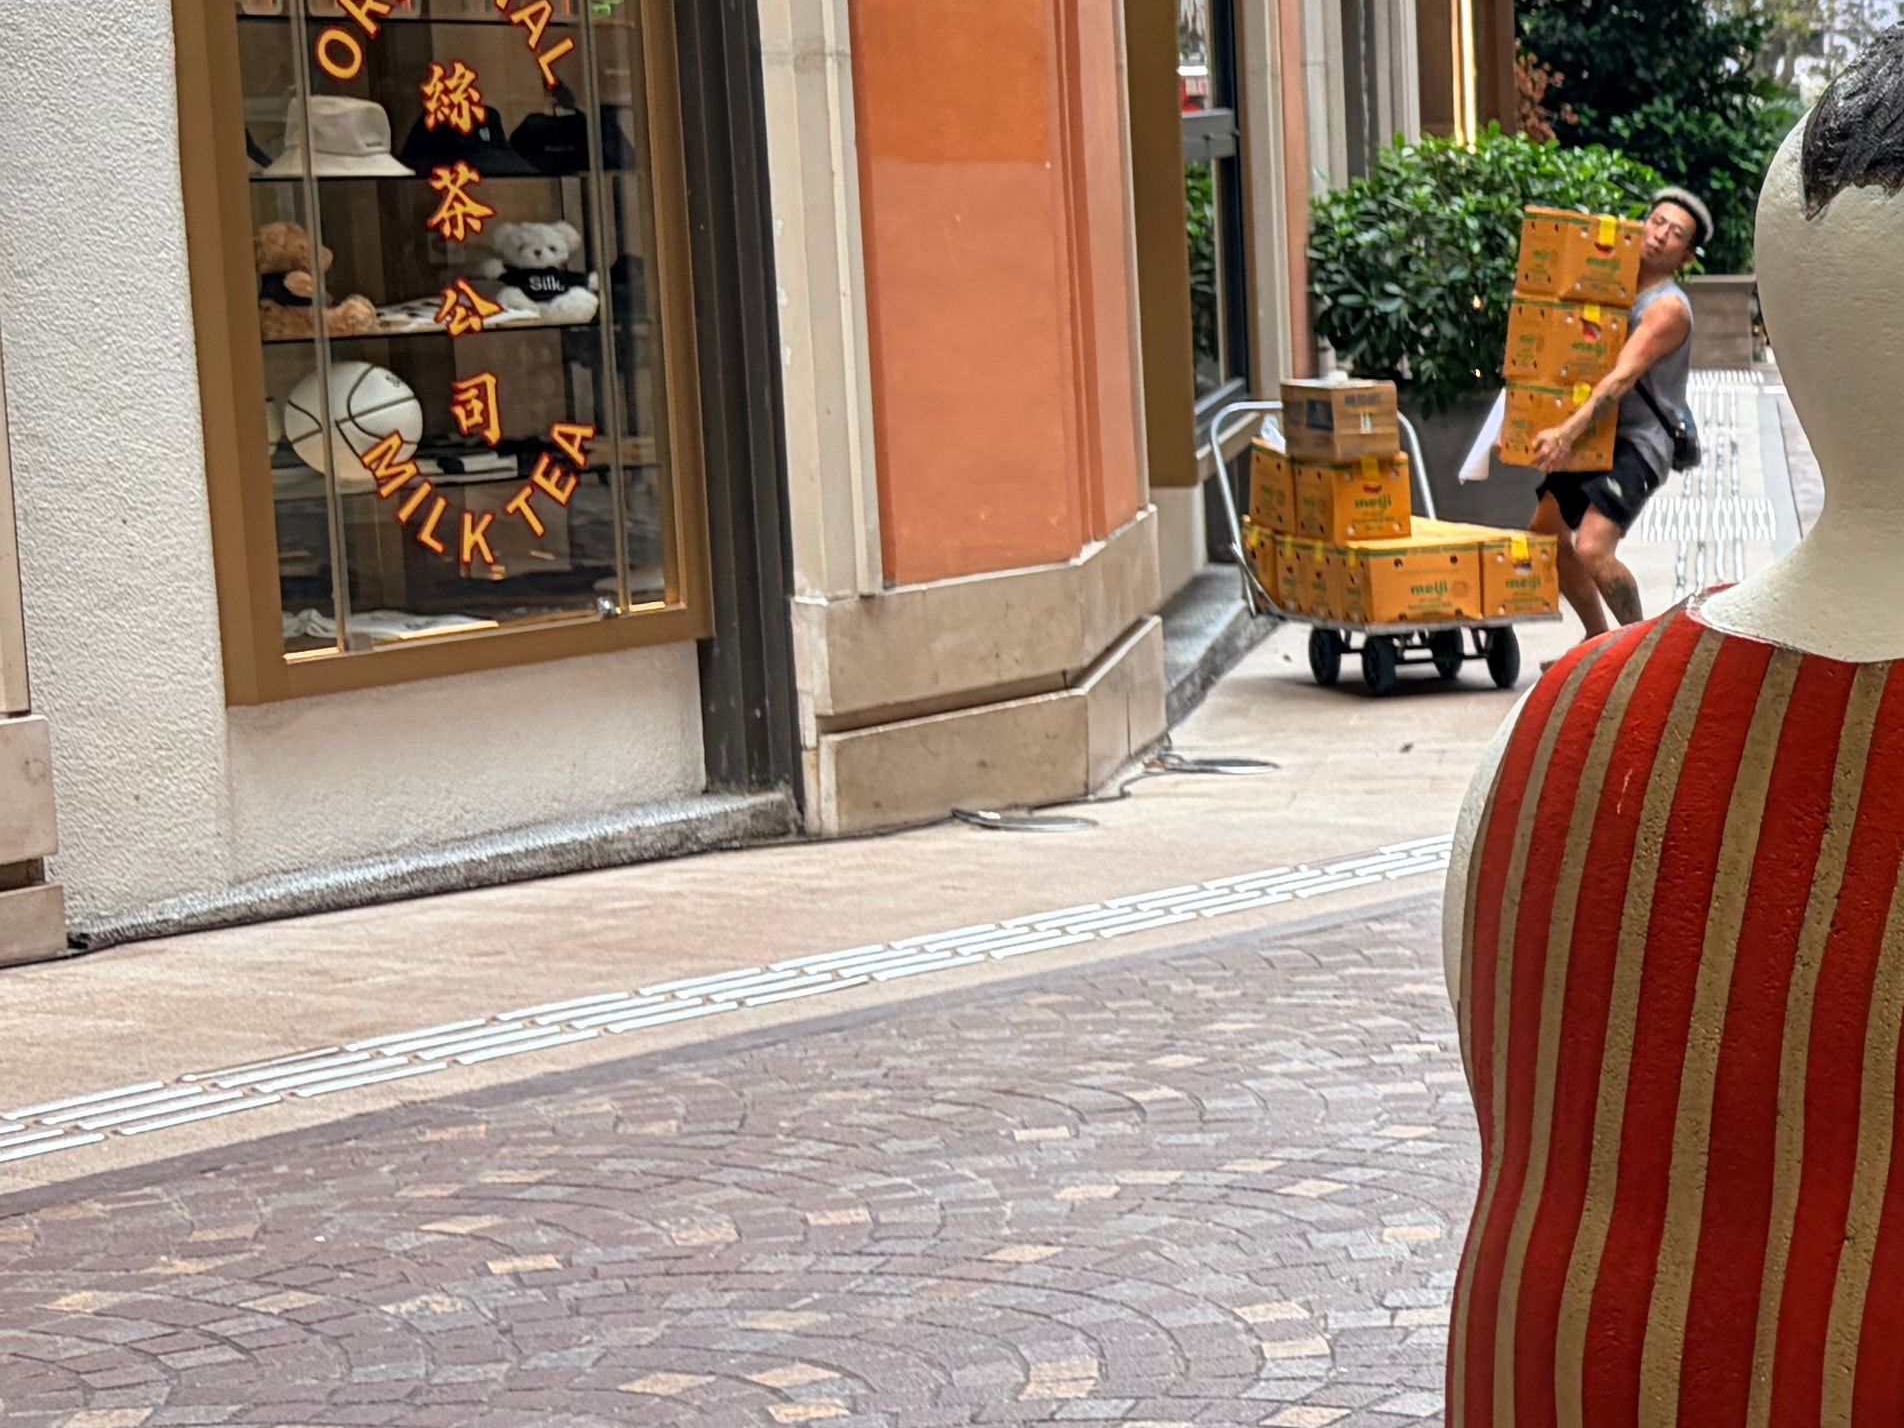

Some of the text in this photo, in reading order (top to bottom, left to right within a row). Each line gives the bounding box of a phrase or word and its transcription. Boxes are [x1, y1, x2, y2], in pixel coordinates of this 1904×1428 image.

[421, 62, 502, 445] 絲茶公司
[362, 422, 597, 565] MILK TEA
[1411, 580, 1448, 597] meiji
